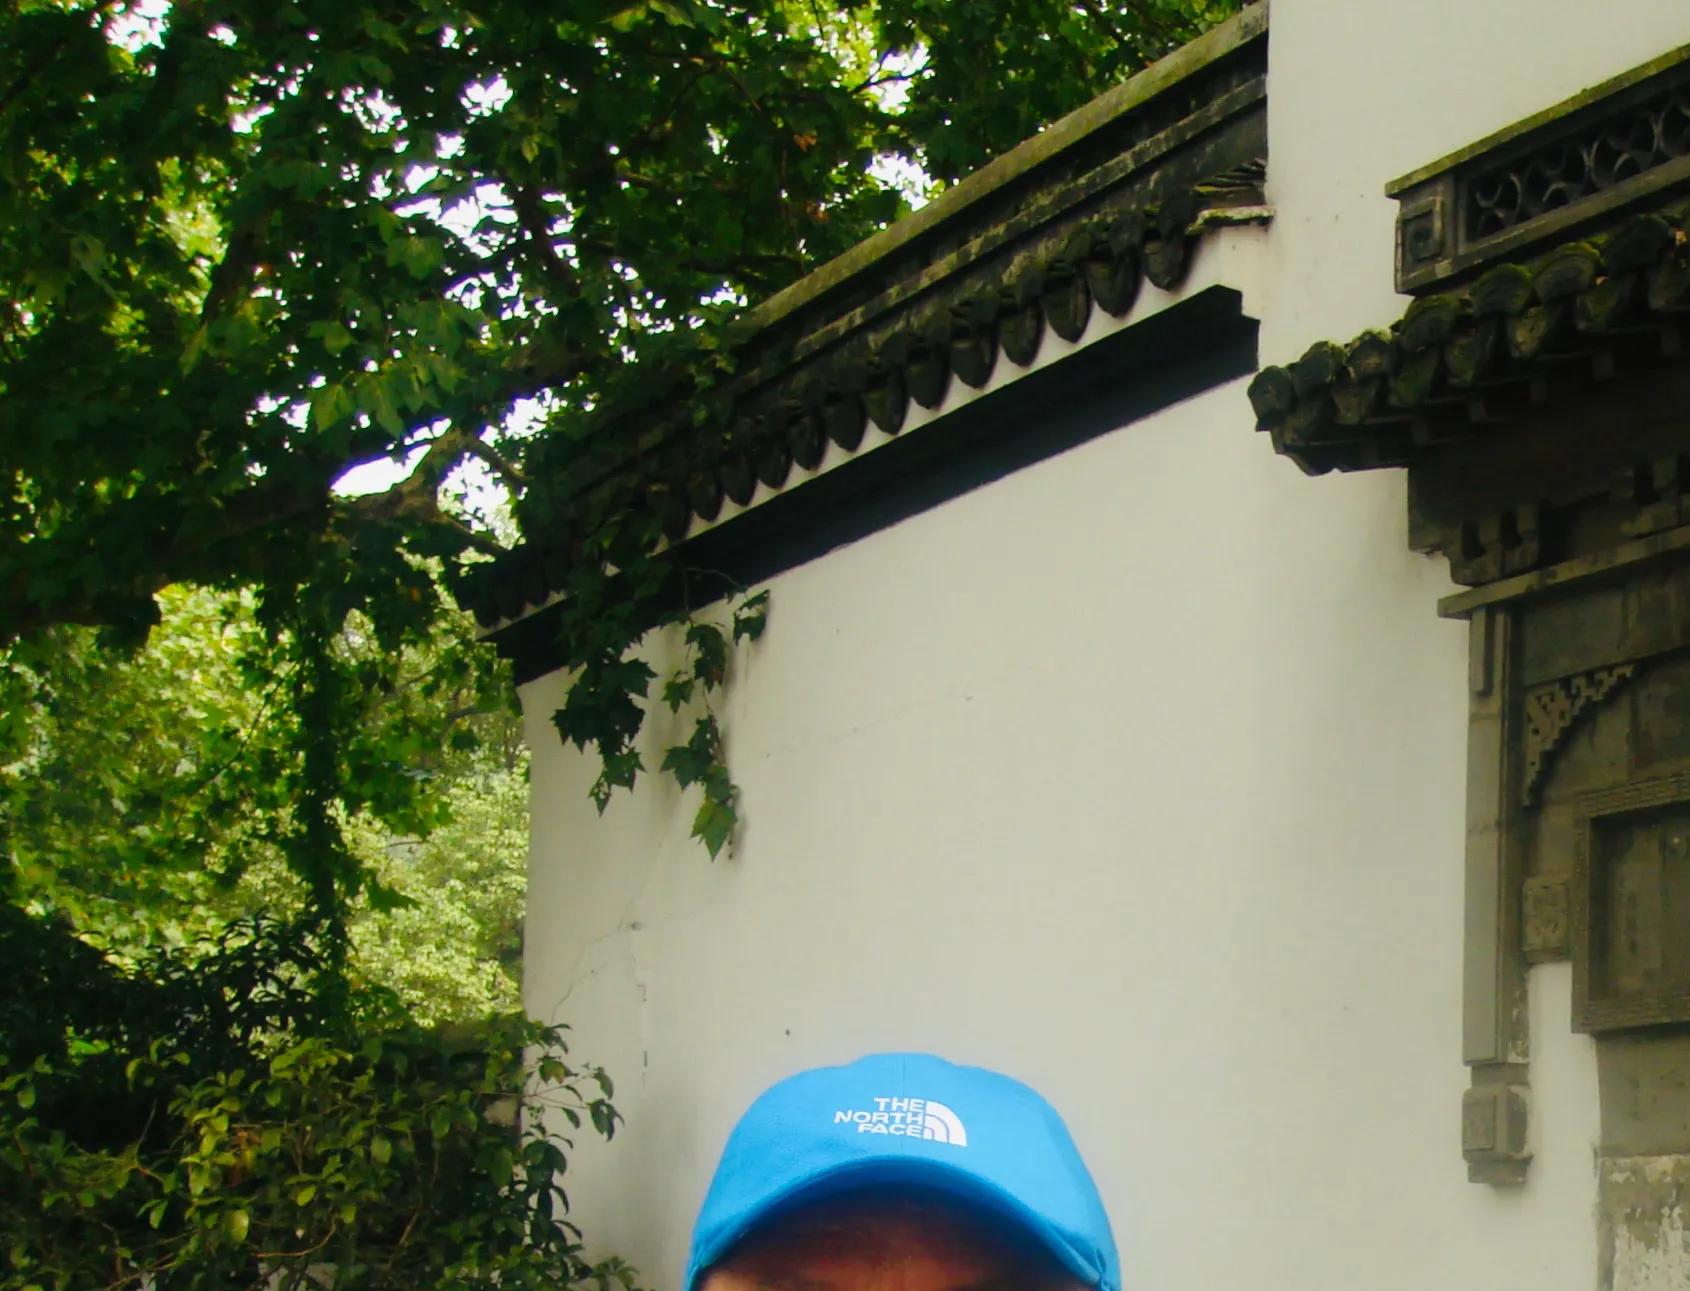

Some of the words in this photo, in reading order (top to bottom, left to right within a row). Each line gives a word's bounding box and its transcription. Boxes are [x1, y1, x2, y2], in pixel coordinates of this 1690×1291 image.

[874, 1097, 925, 1112] THE
[834, 1110, 924, 1124] NORTH
[857, 1123, 922, 1137] FACE
